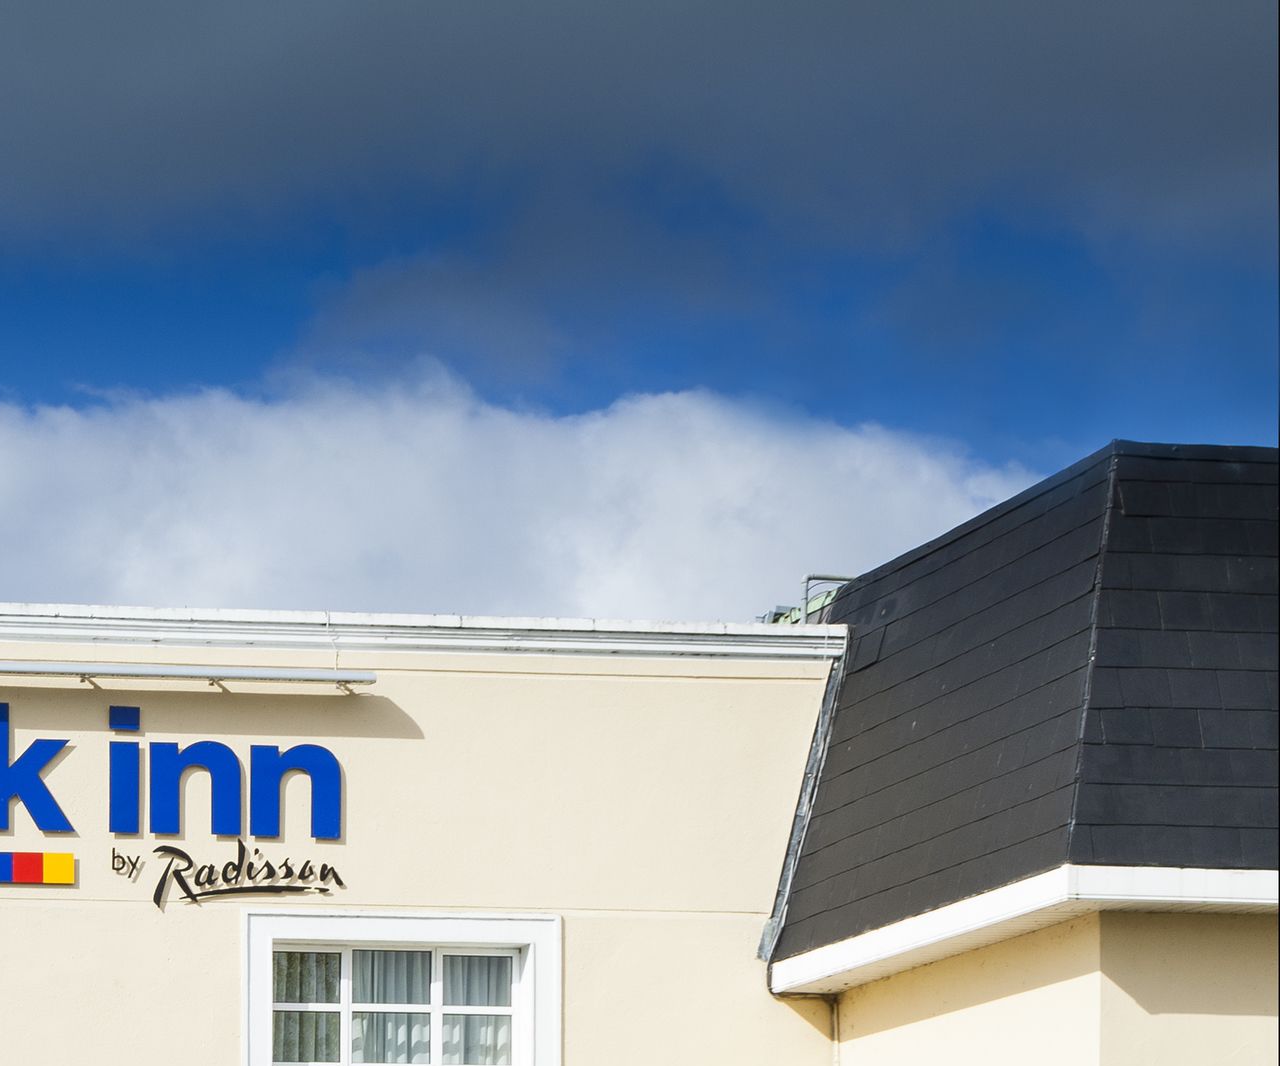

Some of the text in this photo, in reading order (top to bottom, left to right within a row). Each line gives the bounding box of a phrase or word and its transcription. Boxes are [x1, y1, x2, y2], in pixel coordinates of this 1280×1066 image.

[109, 705, 341, 839] inn
[111, 838, 344, 908] by Radisson
